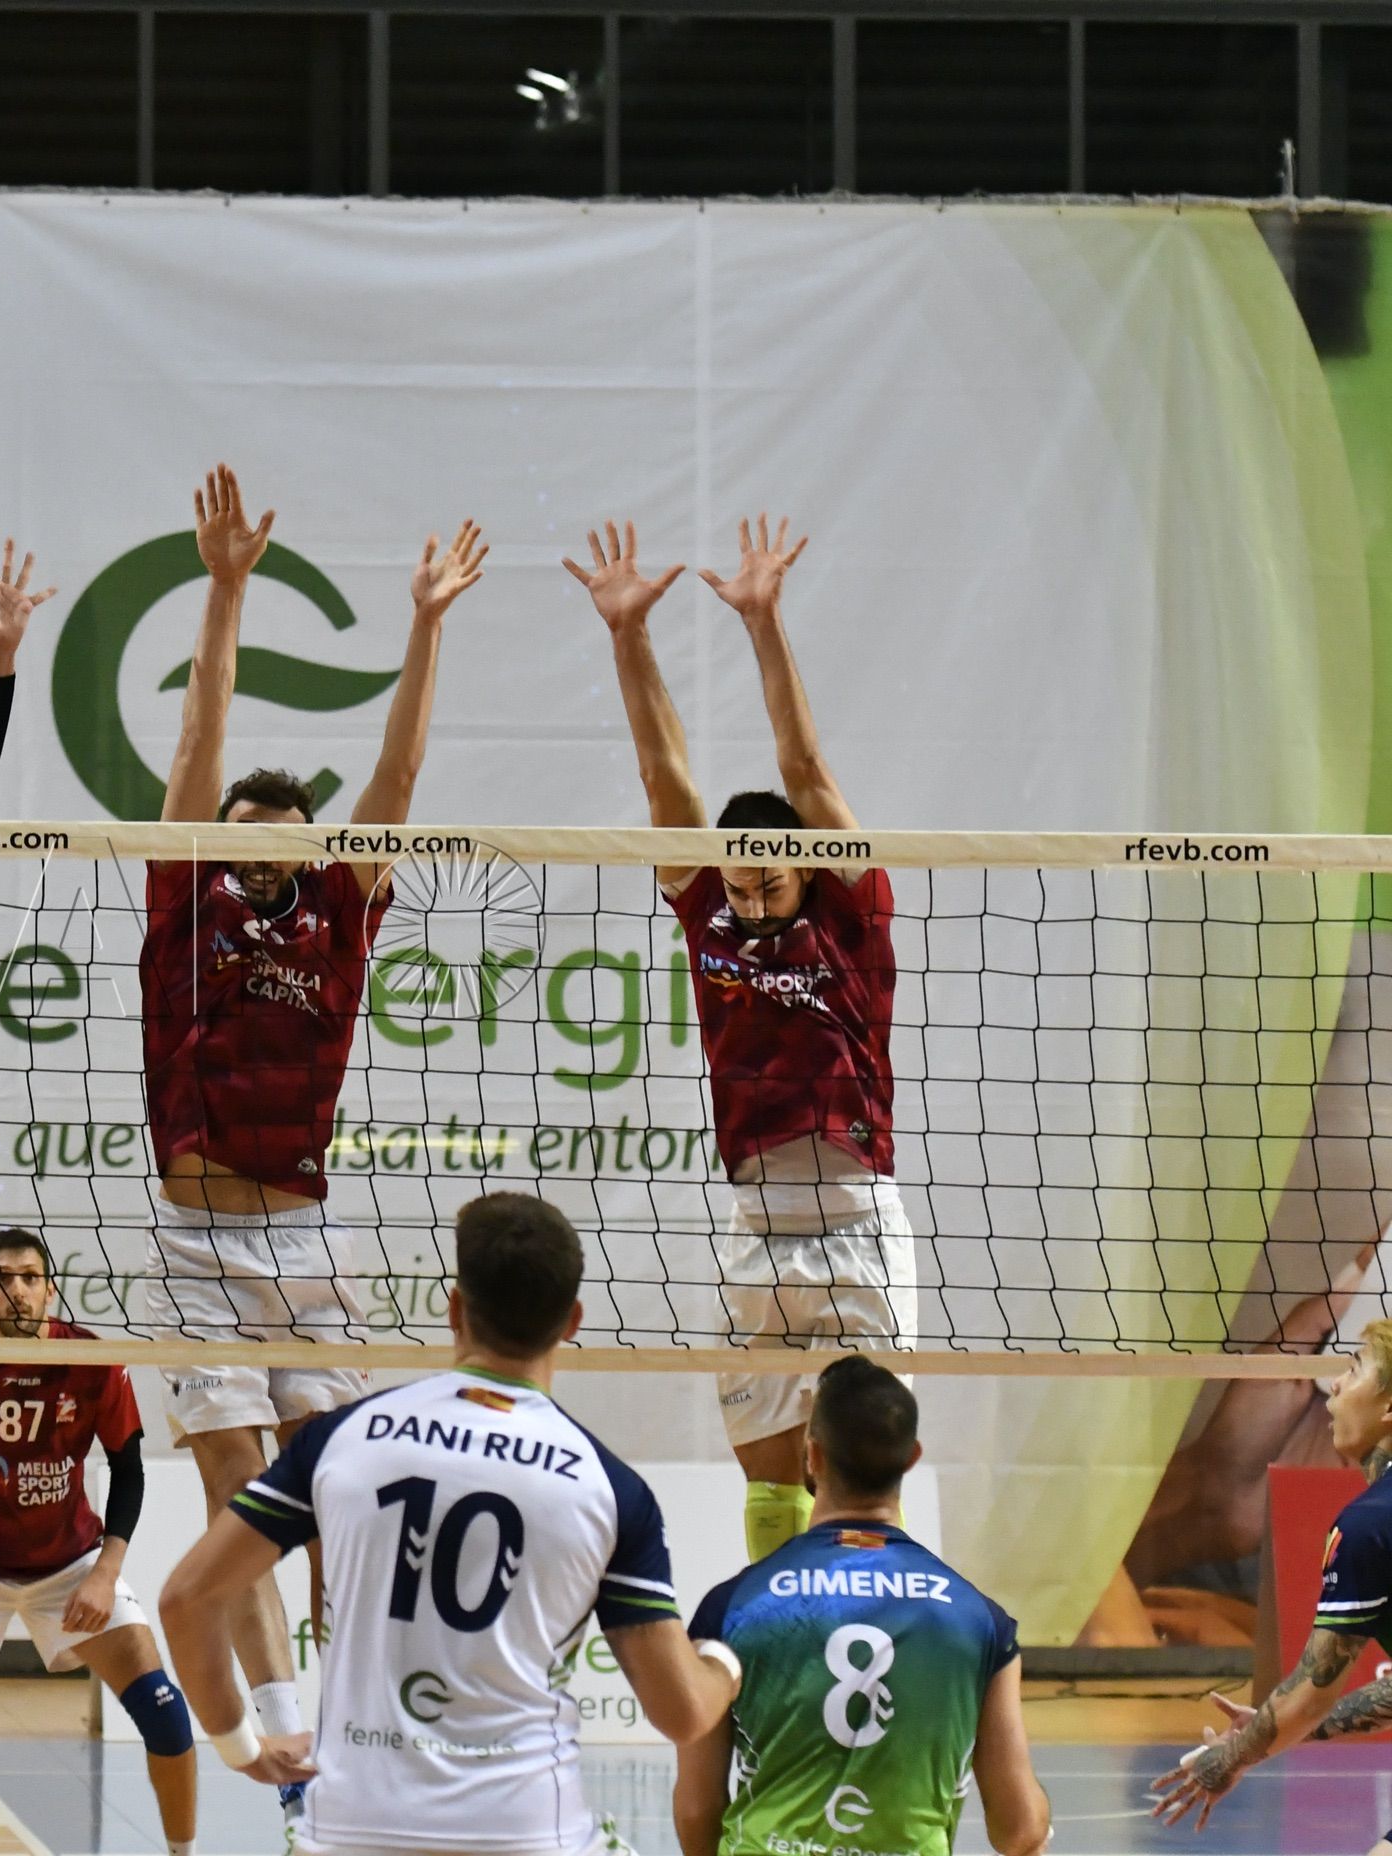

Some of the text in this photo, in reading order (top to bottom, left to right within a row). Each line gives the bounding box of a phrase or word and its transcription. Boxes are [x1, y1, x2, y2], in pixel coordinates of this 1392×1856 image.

[325, 831, 472, 855] rfevb.com
[725, 835, 872, 859] rfevb.com
[1124, 838, 1270, 862] rfevb.com
[13, 1121, 136, 1181] que
[441, 1112, 508, 1172] tu
[527, 1114, 722, 1173] entor
[365, 1413, 584, 1481] DANI RUIZ
[17, 1455, 76, 1476] MELILLA
[18, 1473, 70, 1492] SPORT
[375, 1475, 525, 1633] 10
[769, 1569, 953, 1604] GIMENEZ
[823, 1623, 895, 1748] 8
[344, 1721, 404, 1750] fenie
